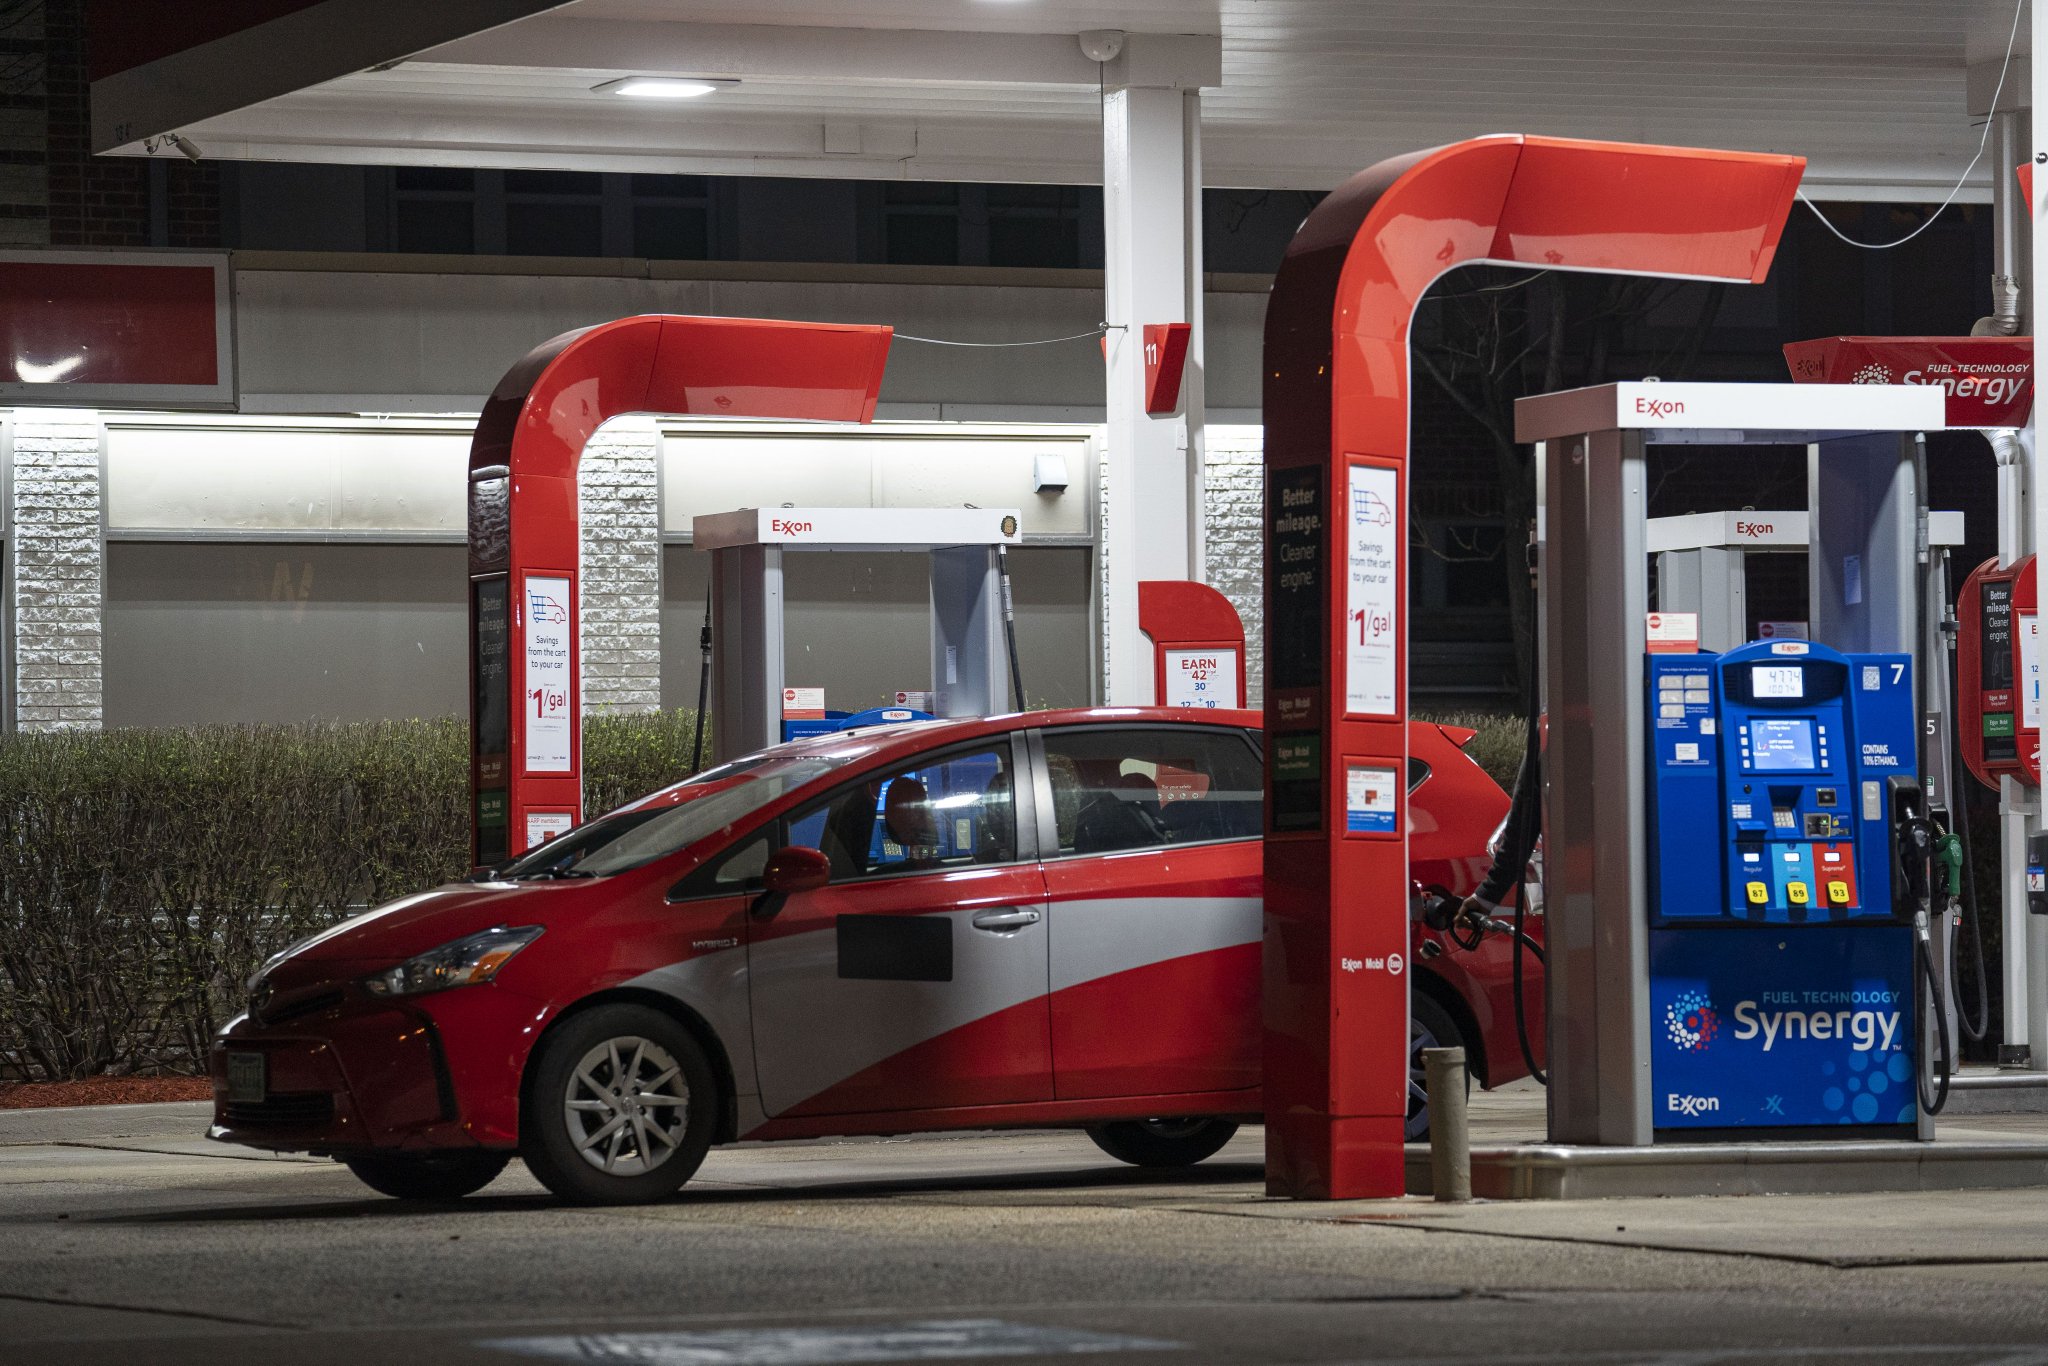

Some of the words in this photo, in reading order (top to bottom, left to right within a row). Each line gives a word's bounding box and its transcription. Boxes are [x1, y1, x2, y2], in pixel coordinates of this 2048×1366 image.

[1145, 343, 1157, 365] 11
[1927, 364, 1953, 373] FUEL
[1957, 364, 2030, 373] TECHNOLOGY
[1636, 398, 1685, 419] Exxon
[1283, 487, 1315, 507] Better
[772, 519, 812, 536] Exxon
[1276, 511, 1321, 535] mileage.
[1736, 521, 1774, 538] Exxon
[1281, 543, 1316, 562] Cleaner
[1358, 540, 1383, 556] Savings
[1350, 554, 1365, 566] from
[1367, 556, 1378, 568] the
[1379, 558, 1391, 569] cart
[1353, 572, 1360, 581] to
[1361, 574, 1377, 585] your
[1378, 575, 1387, 583] car
[1990, 591, 2008, 600] Better
[482, 597, 502, 611] Better
[1986, 602, 2010, 614] mileage.
[1989, 617, 2009, 628] Cleaner
[536, 635, 559, 646] Savings
[528, 646, 543, 656] from
[543, 648, 554, 657] the
[531, 660, 539, 668] to
[540, 662, 553, 670] your
[1181, 658, 1217, 670] EARN
[1191, 669, 1207, 681] 42
[1890, 664, 1905, 685] 7
[1194, 682, 1206, 691] 30
[1205, 700, 1216, 709] 10
[1926, 719, 1936, 735] 5
[1862, 744, 1889, 755] CONTAINS
[1863, 755, 1875, 766] 10%
[1875, 755, 1899, 766] ETHANOL
[1744, 866, 1763, 874] Regular
[1752, 889, 1763, 898] 87
[1793, 889, 1805, 898] 89
[1833, 888, 1845, 897] 93
[1341, 957, 1363, 973] Exxon
[1365, 957, 1384, 970] Mobil
[1763, 991, 1798, 1004] FUEL
[1803, 991, 1900, 1004] TECHNOLOGY
[1734, 1000, 1901, 1051] Synergy
[1668, 1093, 1719, 1116] Exxon
